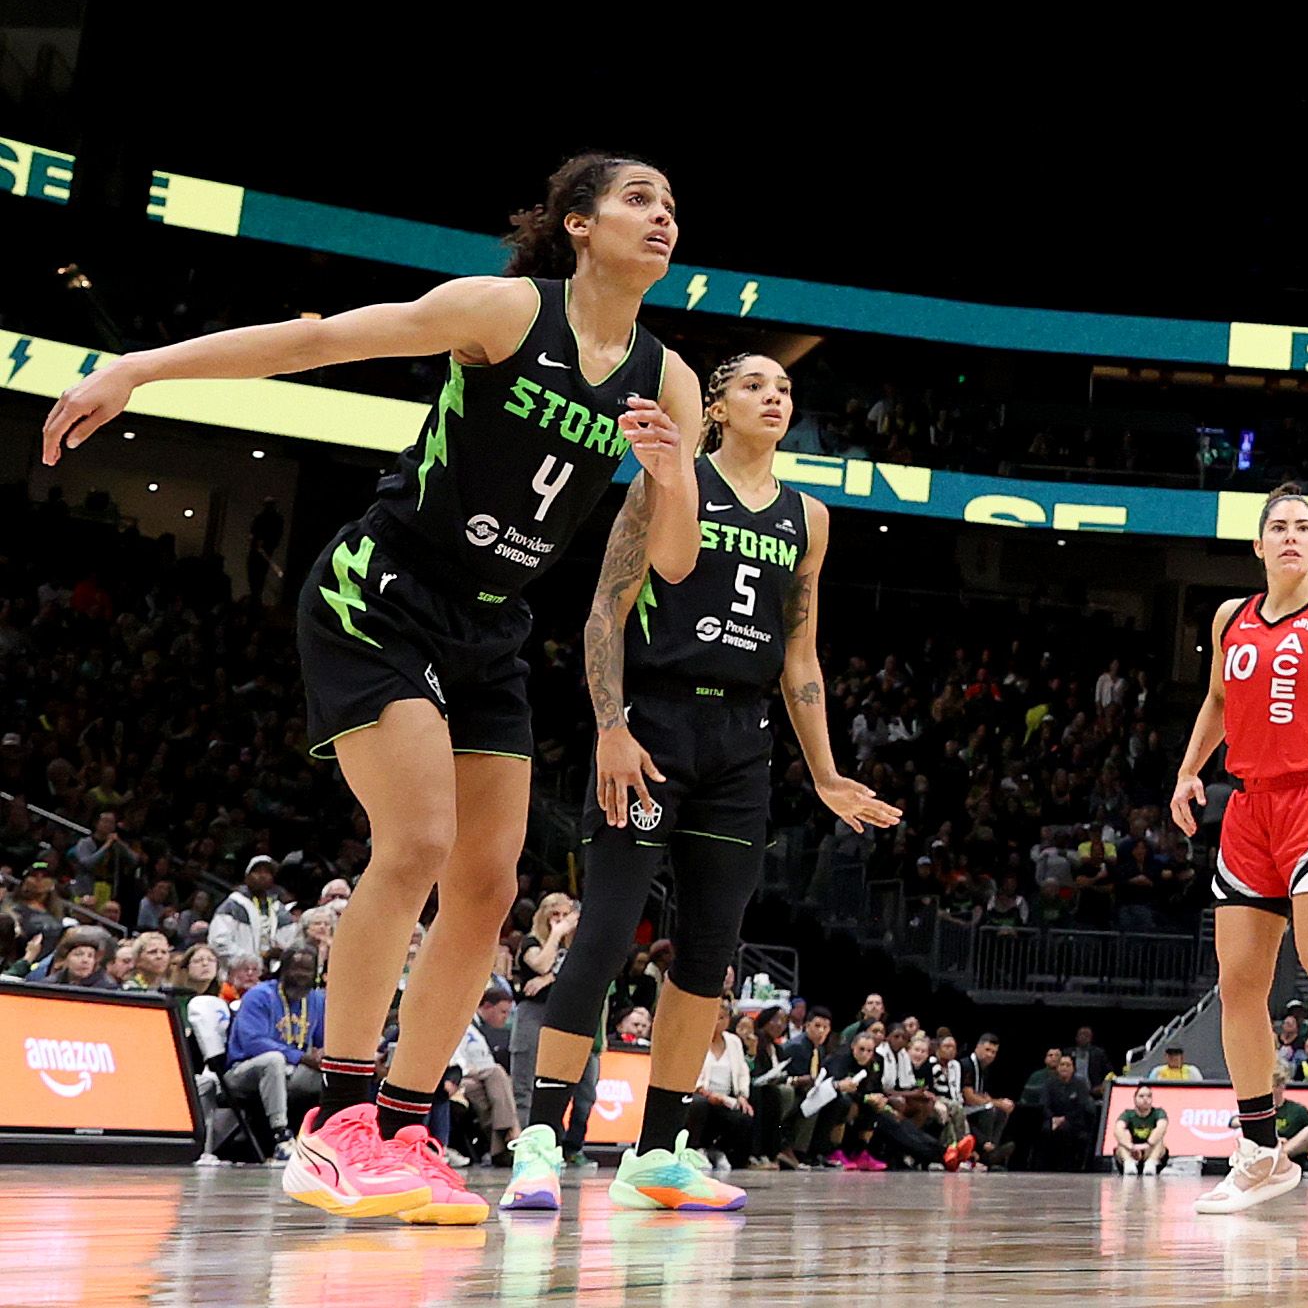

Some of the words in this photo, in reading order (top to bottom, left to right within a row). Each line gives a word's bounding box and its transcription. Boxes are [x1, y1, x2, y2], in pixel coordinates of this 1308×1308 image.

[503, 376, 632, 461] STORM
[531, 454, 575, 523] 4
[494, 543, 541, 569] SWEDISH
[699, 520, 798, 572] STORM
[730, 563, 761, 617] 5
[721, 633, 759, 652] SWEDISH
[724, 619, 772, 643] Providence
[1223, 643, 1259, 682] 10
[1268, 632, 1304, 725] ACES
[24, 1037, 116, 1073] amazon
[1181, 1108, 1239, 1127] ama
